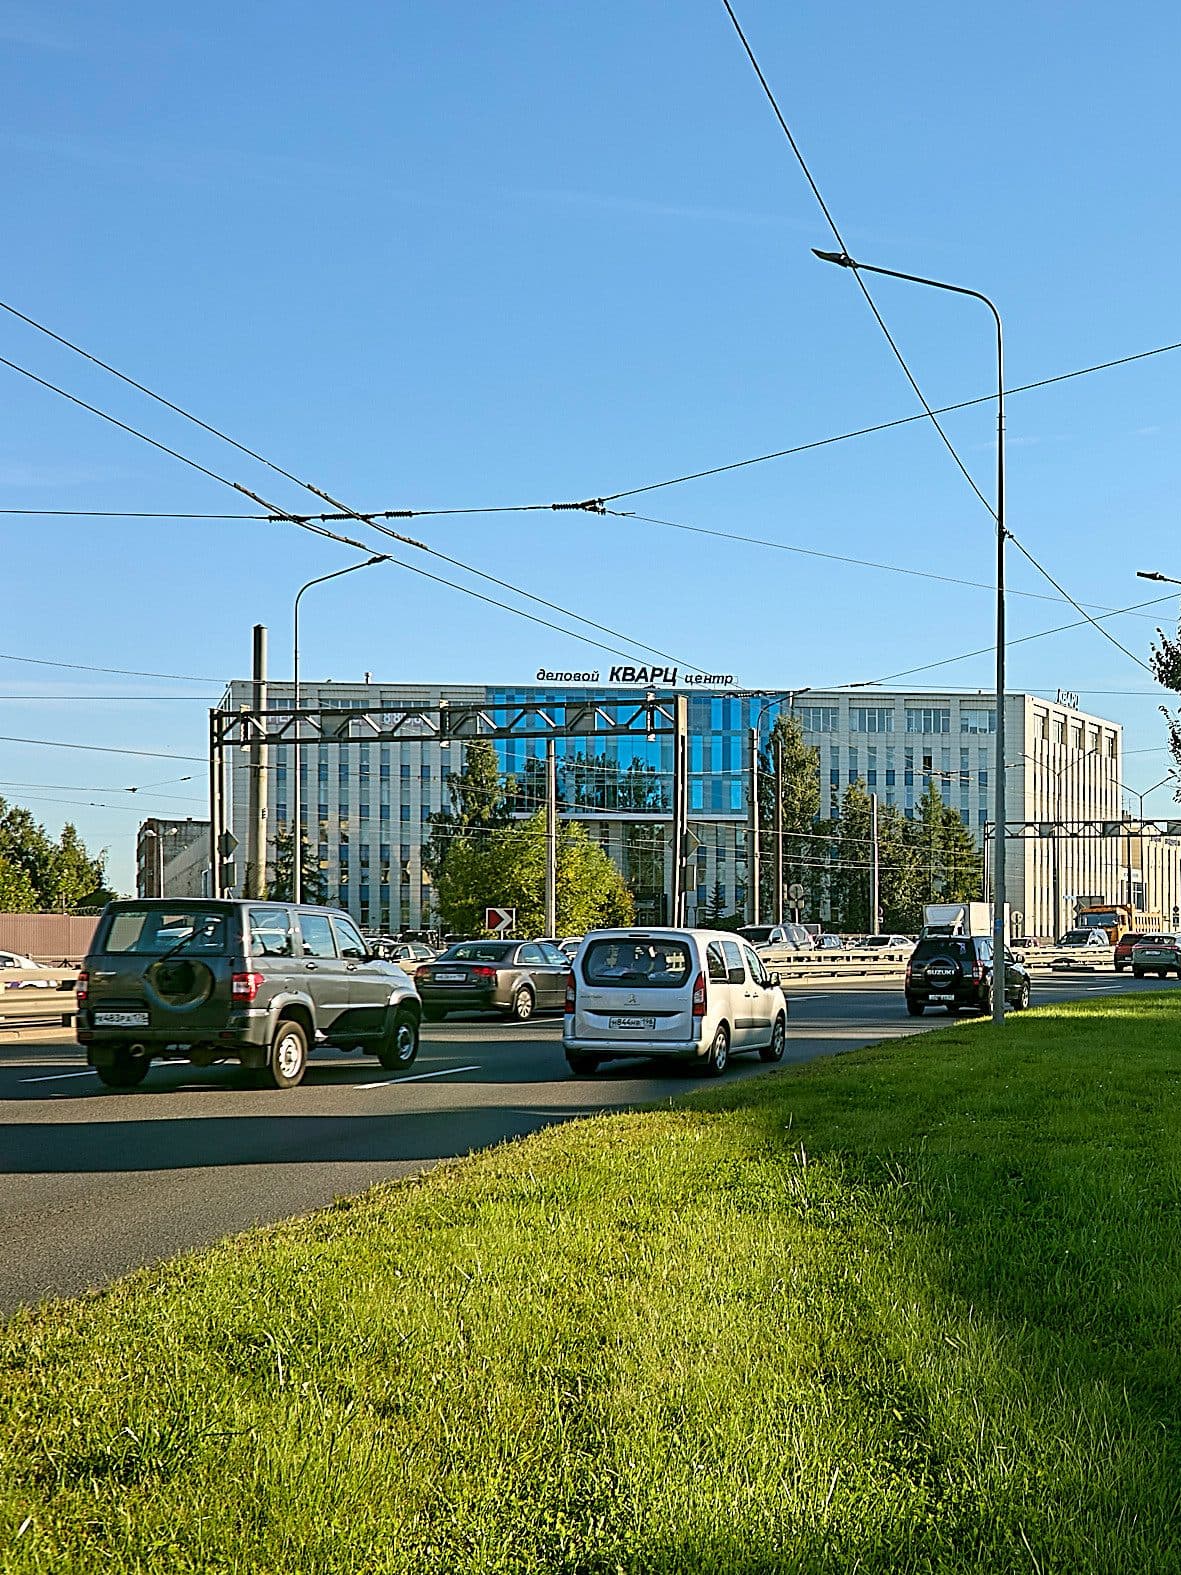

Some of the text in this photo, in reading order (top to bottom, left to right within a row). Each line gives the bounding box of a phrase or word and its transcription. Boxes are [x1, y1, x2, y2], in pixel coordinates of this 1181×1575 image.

[536, 666, 734, 686] деловой КВАРЦ центр
